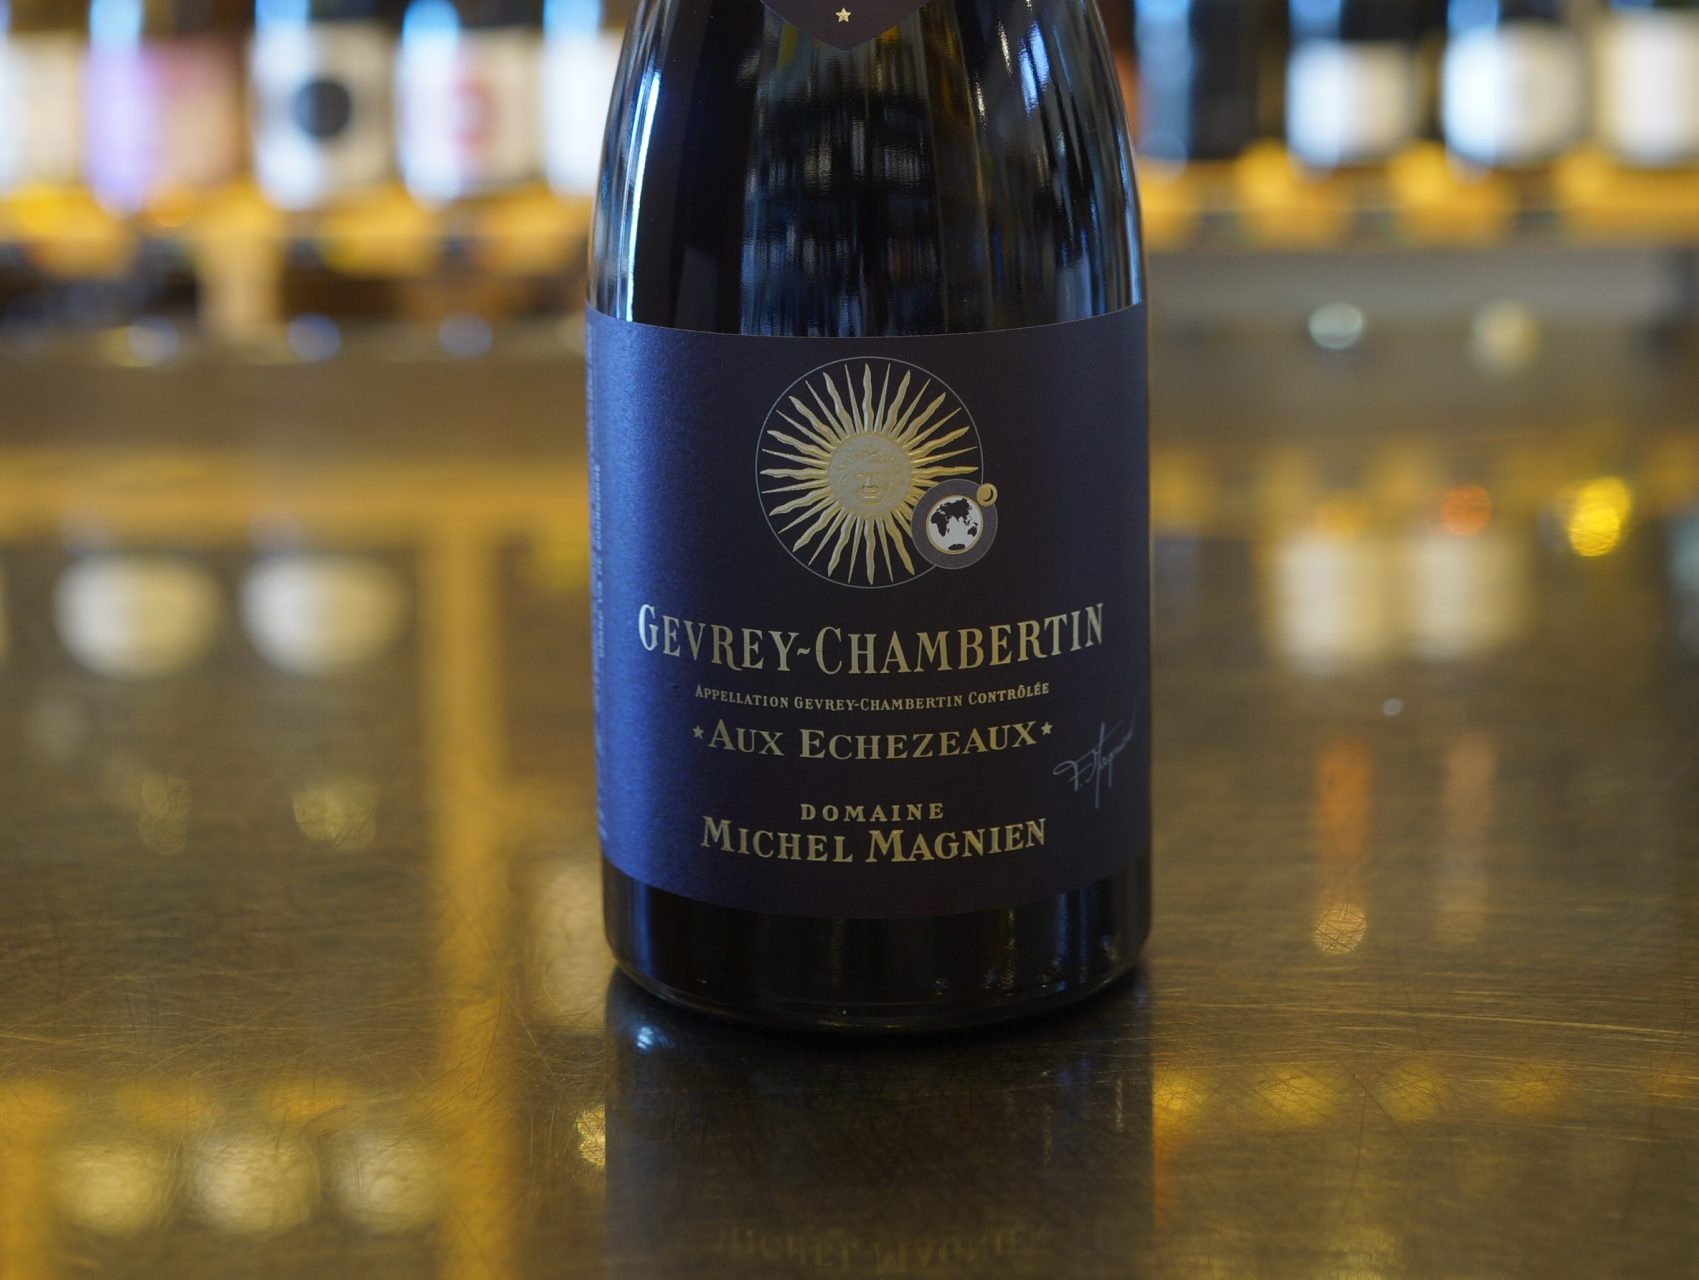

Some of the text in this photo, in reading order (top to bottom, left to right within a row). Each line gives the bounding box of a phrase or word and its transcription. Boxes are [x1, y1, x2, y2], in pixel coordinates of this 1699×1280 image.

[638, 603, 1104, 675] GEVREY-CHAMBERTIN
[695, 682, 1050, 711] APPELLATION GEVREY-CHAMBERTIN CONTRÔLÉE
[708, 718, 1037, 760] AUX ECHEZEAUX
[800, 802, 945, 822] DOMAINE
[701, 815, 1047, 863] MICHEL MAGNIEN
